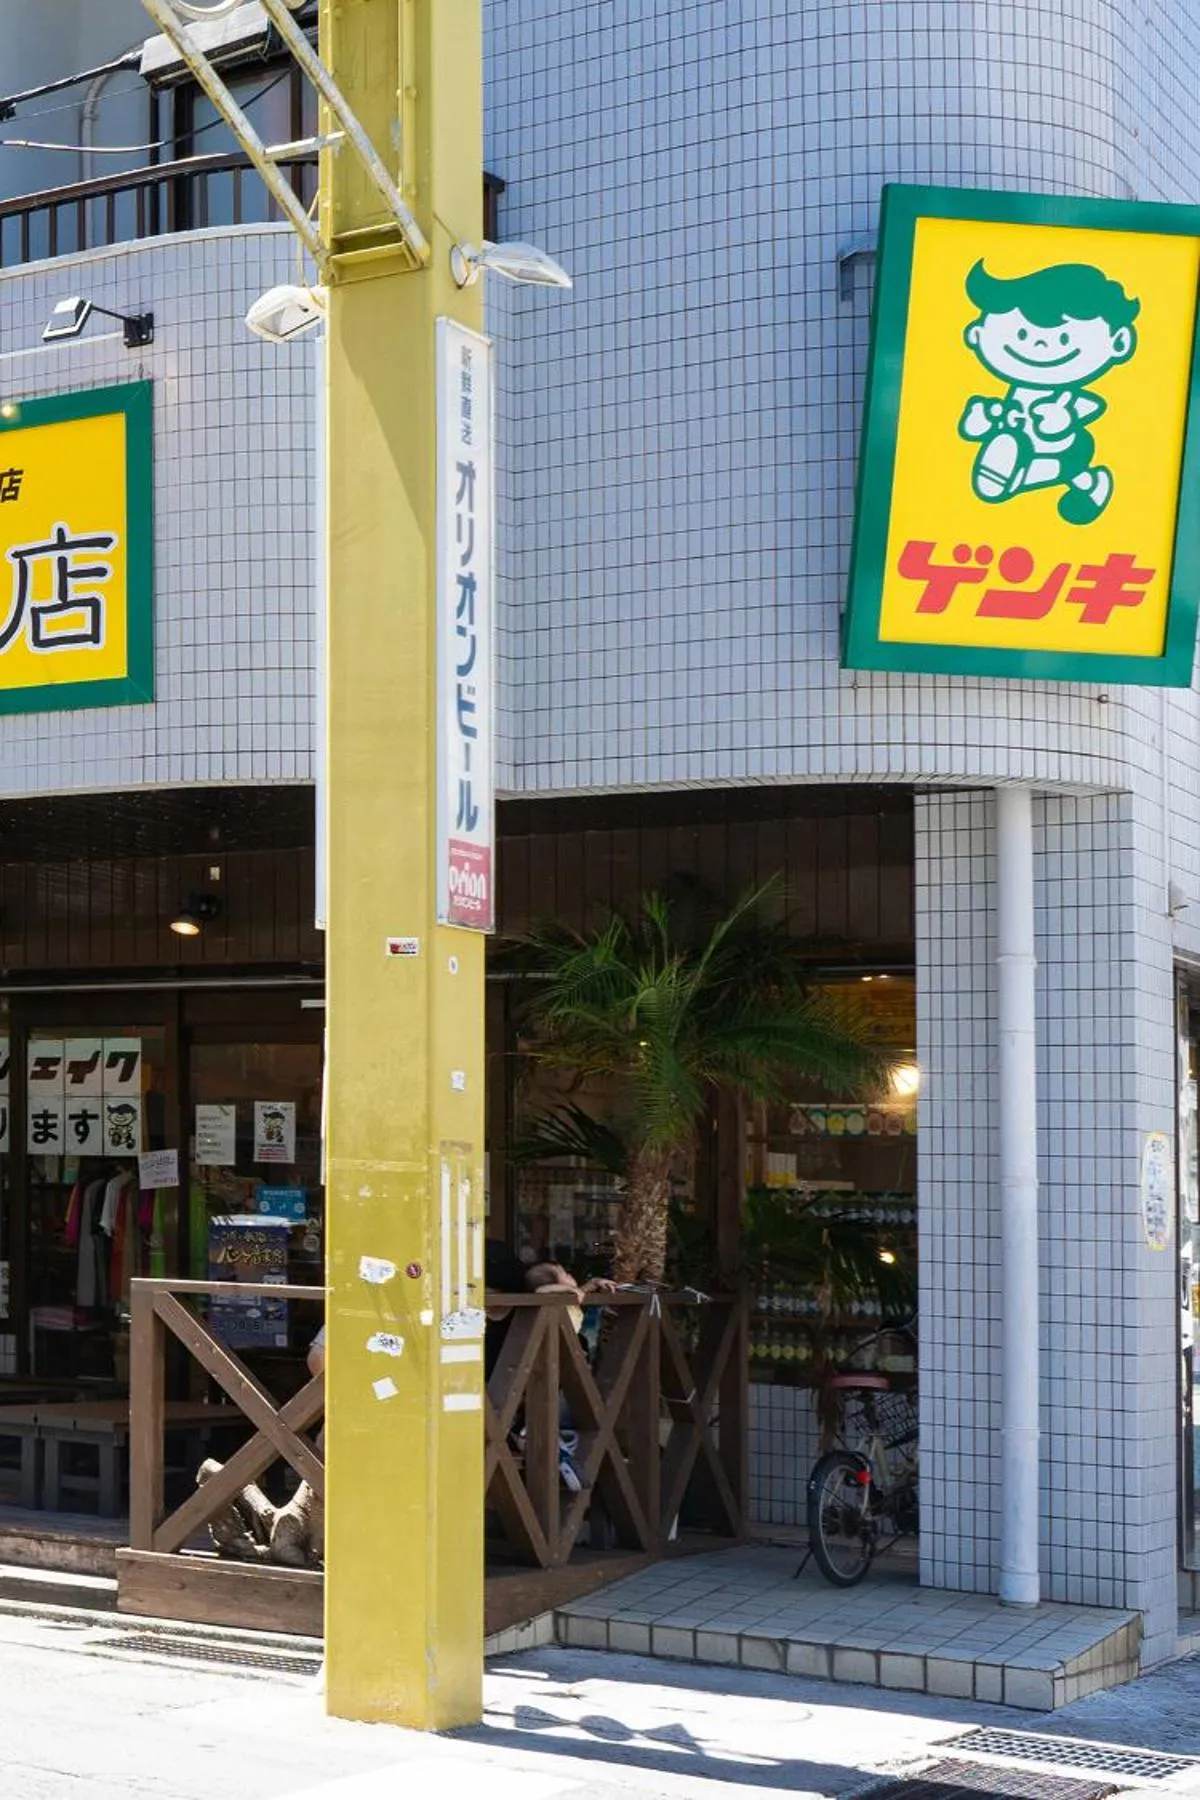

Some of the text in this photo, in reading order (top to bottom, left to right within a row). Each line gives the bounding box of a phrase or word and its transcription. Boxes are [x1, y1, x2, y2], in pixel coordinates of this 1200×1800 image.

[454, 459, 480, 833] オリオンビール
[897, 540, 1156, 625] ゲンキ
